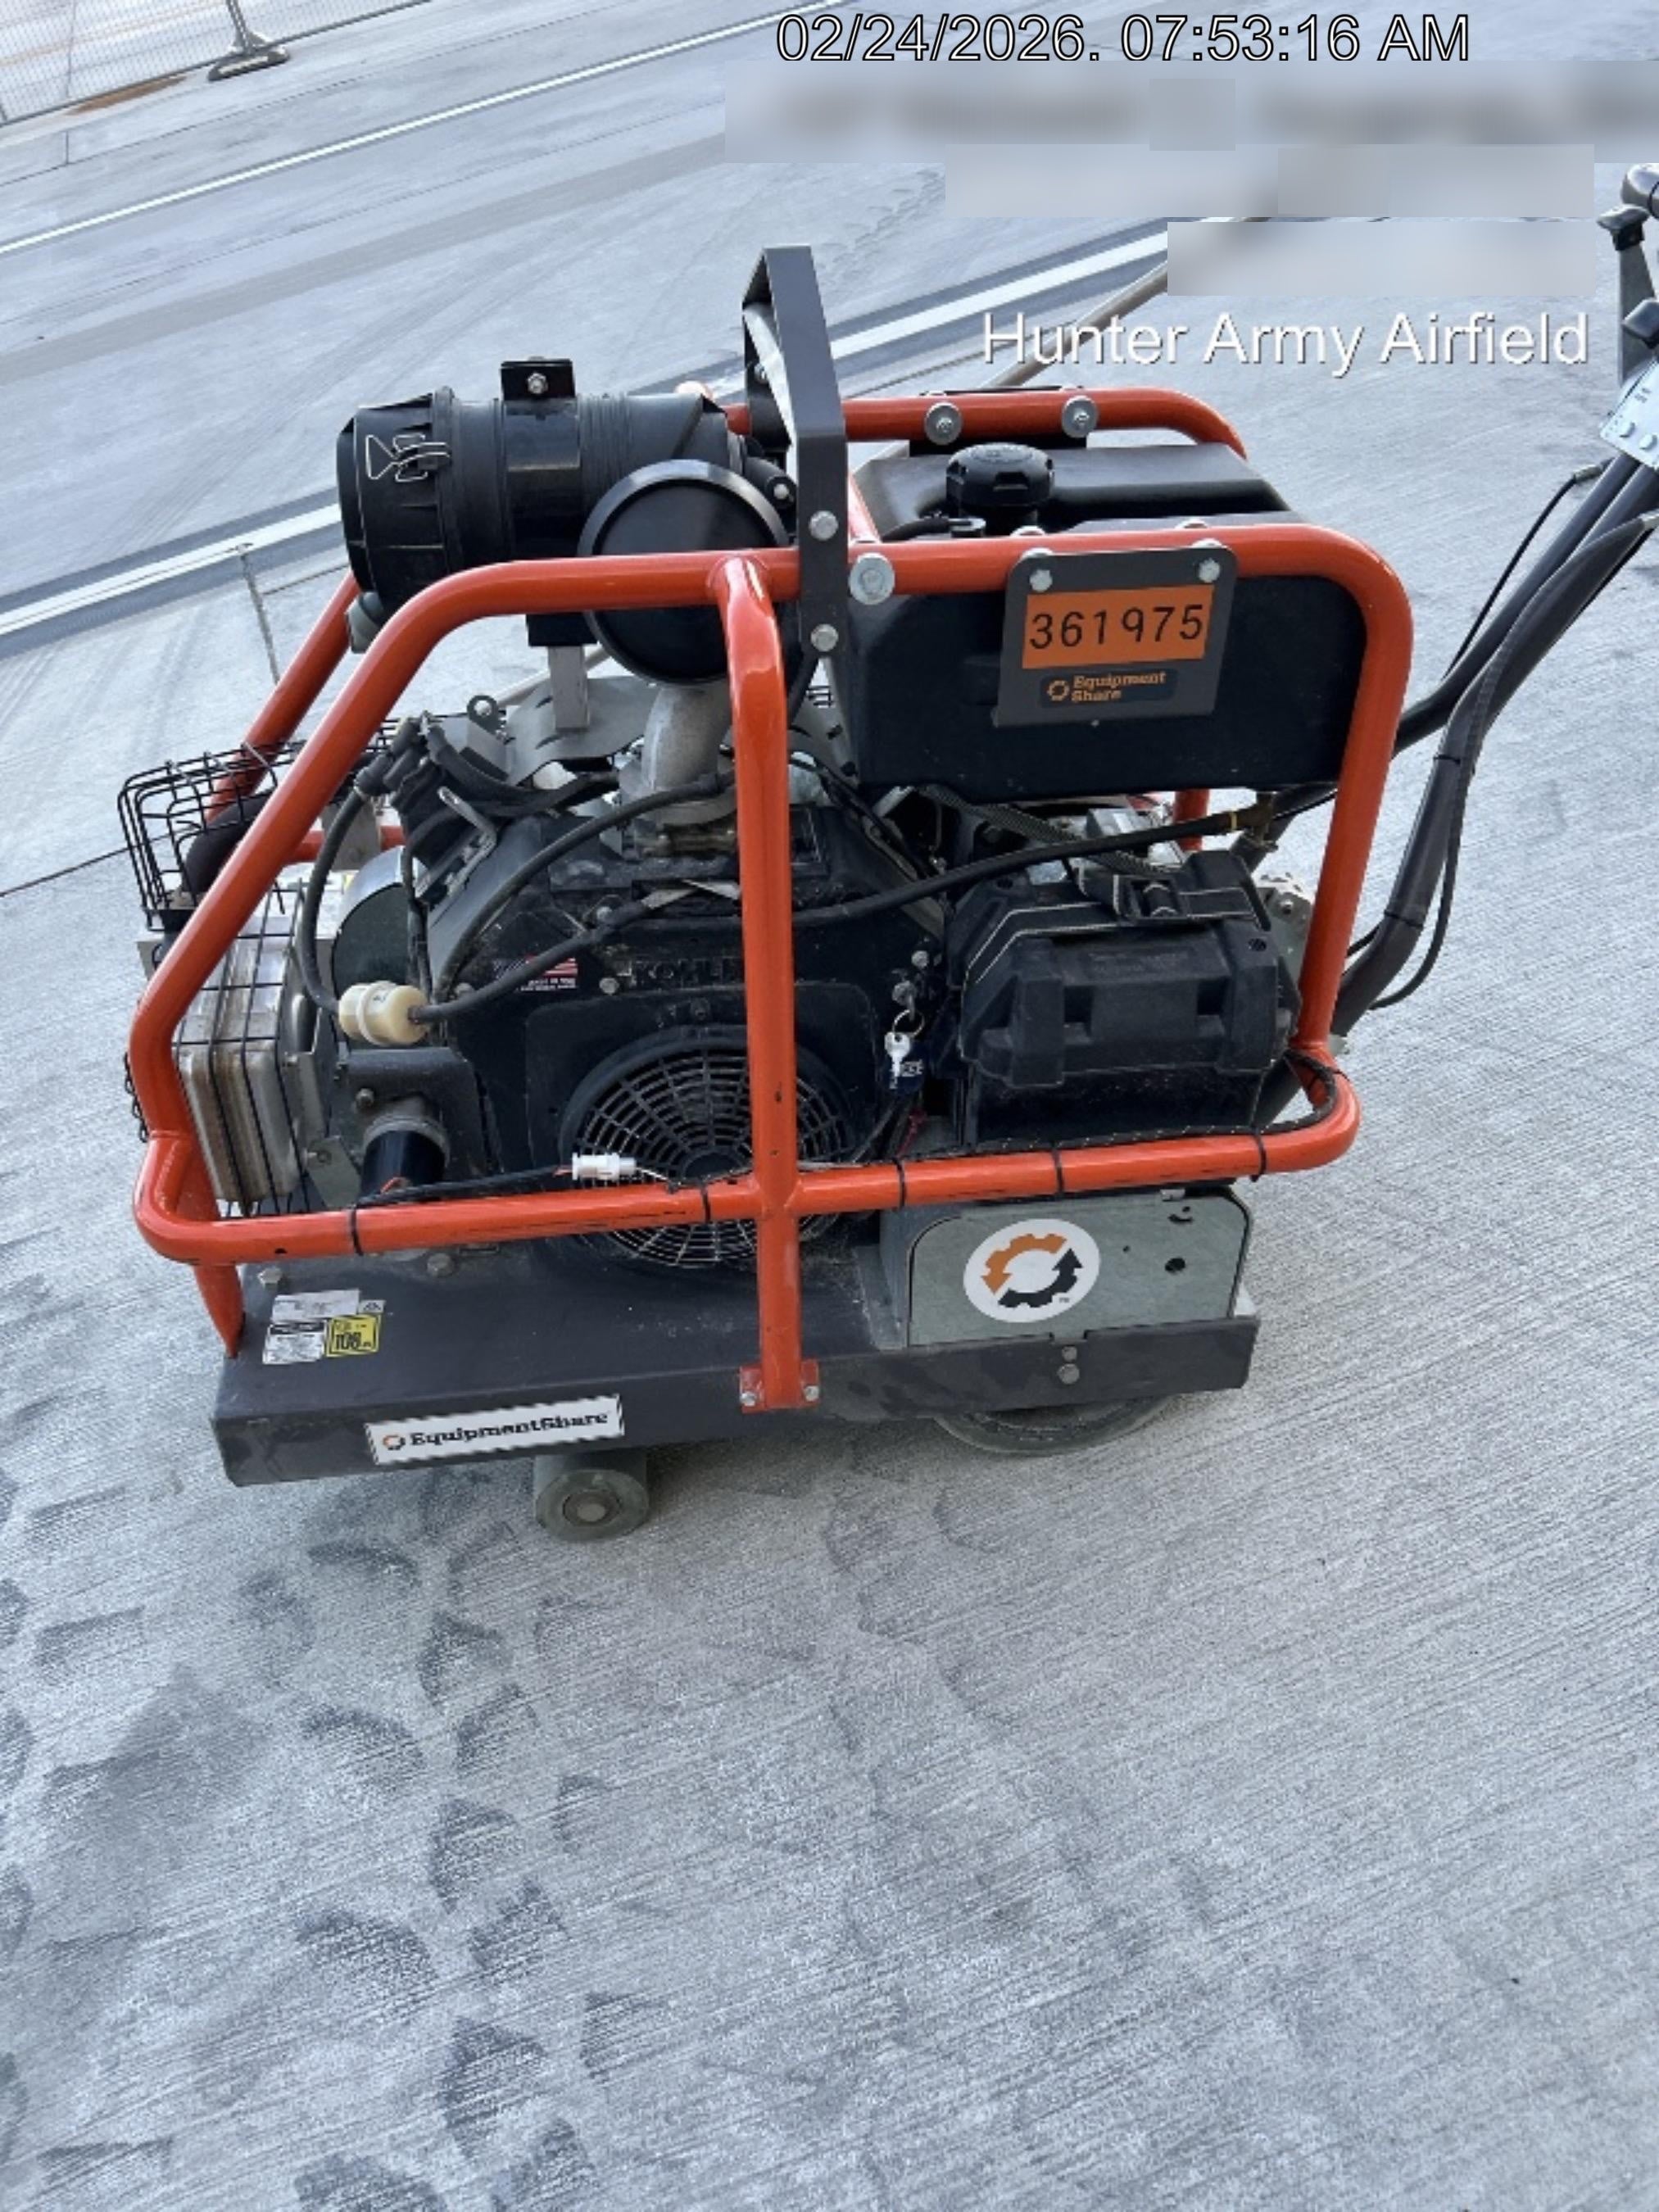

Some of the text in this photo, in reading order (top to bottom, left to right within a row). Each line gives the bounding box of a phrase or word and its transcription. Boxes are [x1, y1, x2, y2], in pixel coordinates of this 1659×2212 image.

[1029, 604, 1203, 650] 361975
[1071, 690, 1122, 703] Share
[1073, 672, 1167, 691] Equipment
[634, 955, 744, 987] KOHLE
[410, 1412, 608, 1445] EquipmentShare
